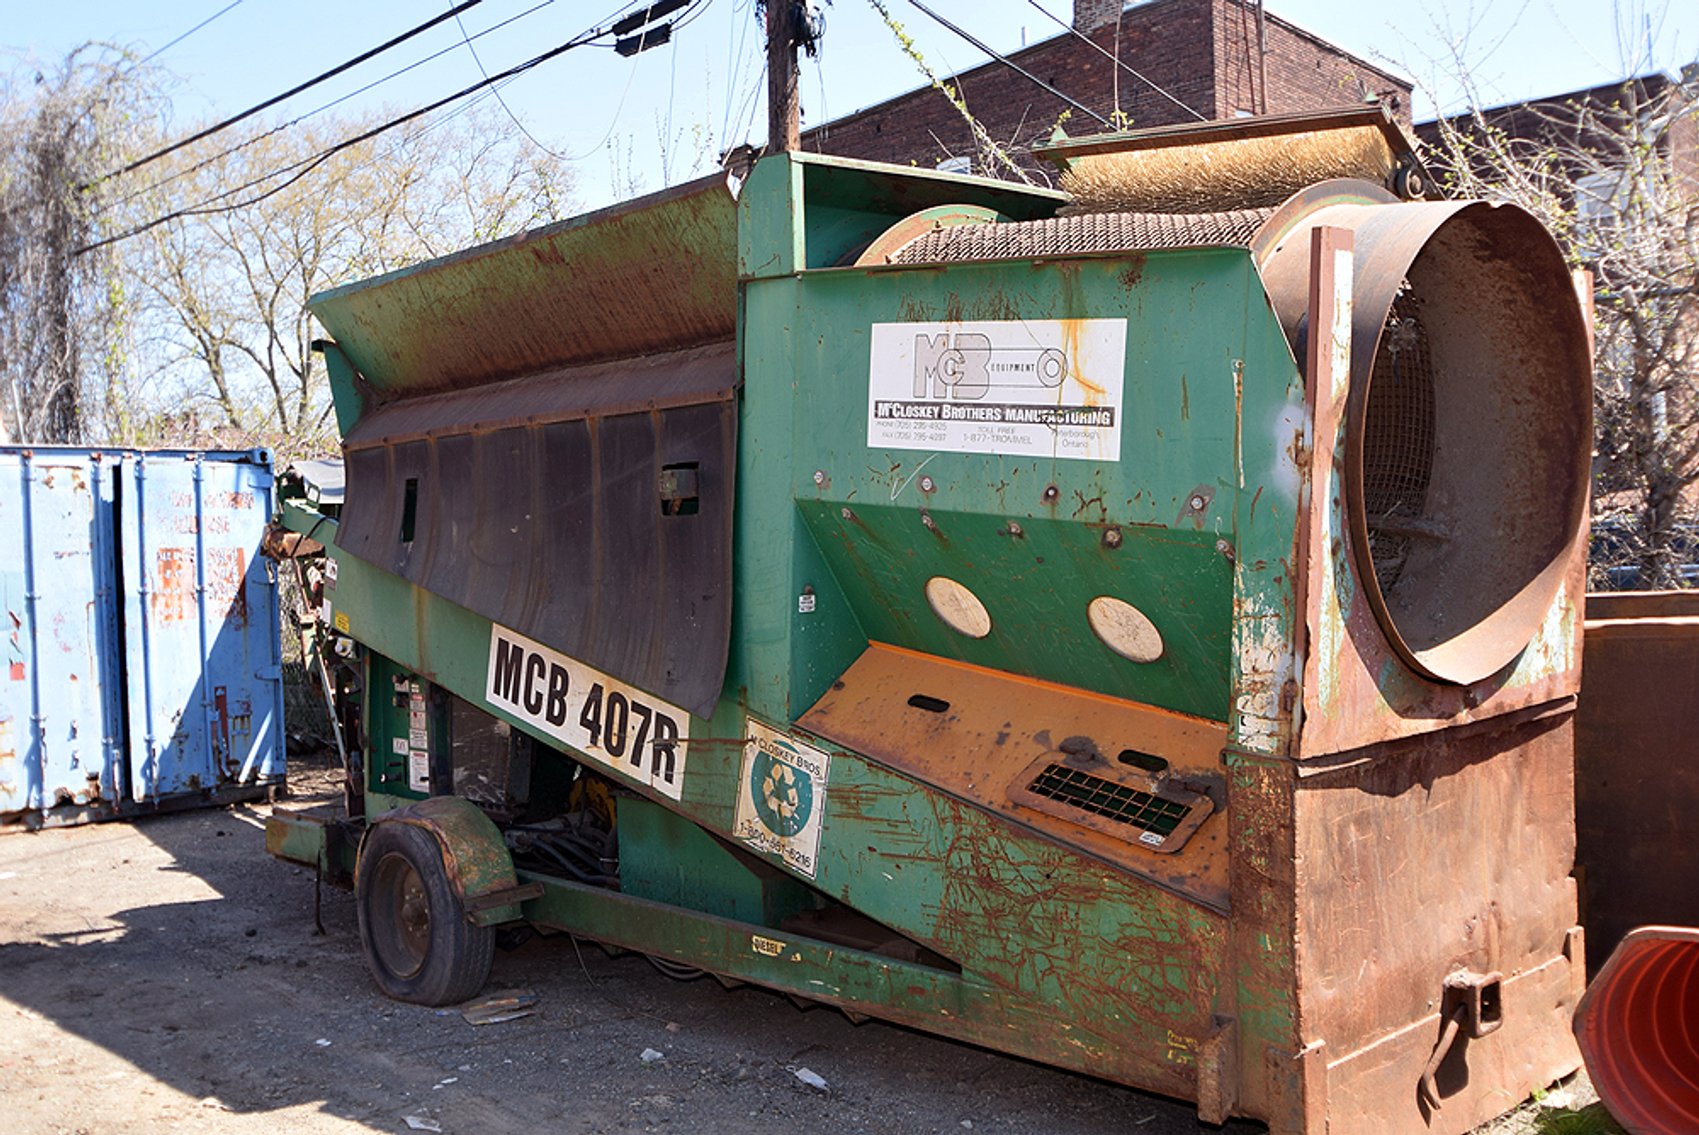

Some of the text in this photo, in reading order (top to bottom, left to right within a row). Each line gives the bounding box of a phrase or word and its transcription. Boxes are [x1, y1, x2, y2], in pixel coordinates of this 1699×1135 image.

[942, 404, 1002, 421] BROTHERS
[493, 637, 679, 785] MCB 407R
